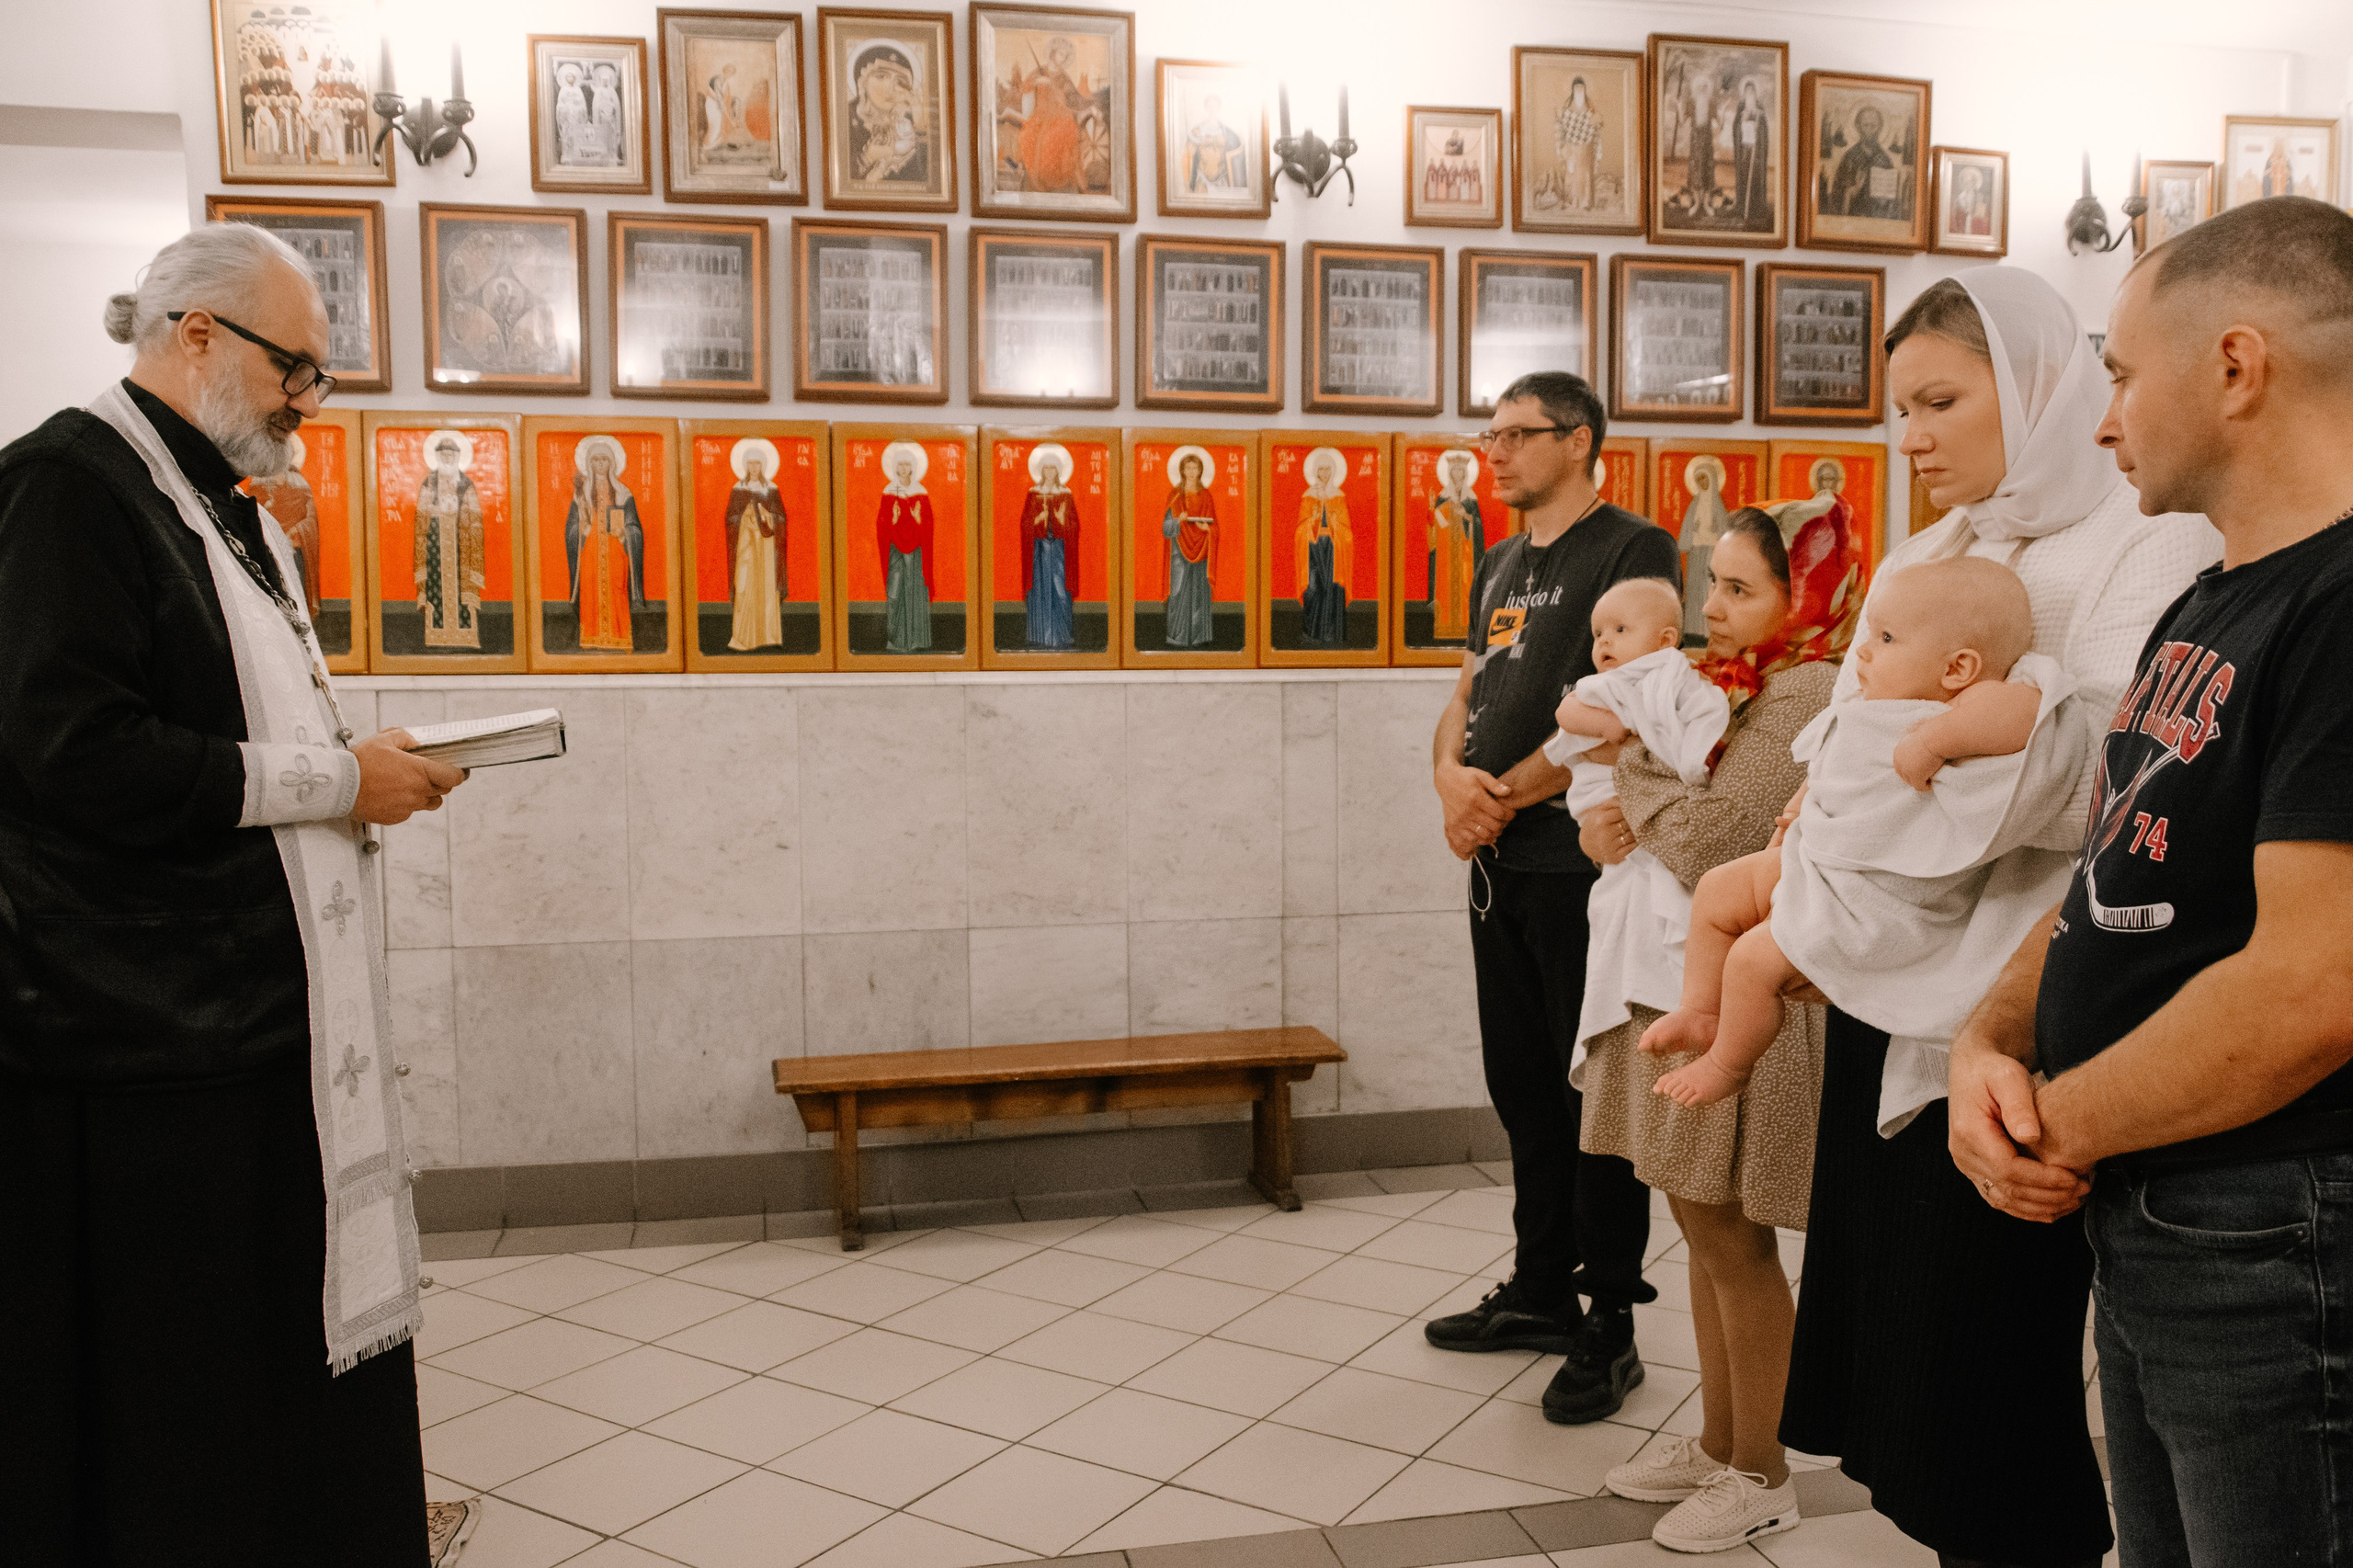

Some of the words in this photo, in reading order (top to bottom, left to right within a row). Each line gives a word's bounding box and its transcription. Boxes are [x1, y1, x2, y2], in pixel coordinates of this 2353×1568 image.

[1505, 590, 1531, 610] just
[1530, 588, 1549, 607] do
[1550, 585, 1563, 605] it
[1495, 615, 1518, 627] NIKE
[2129, 811, 2169, 862] 74
